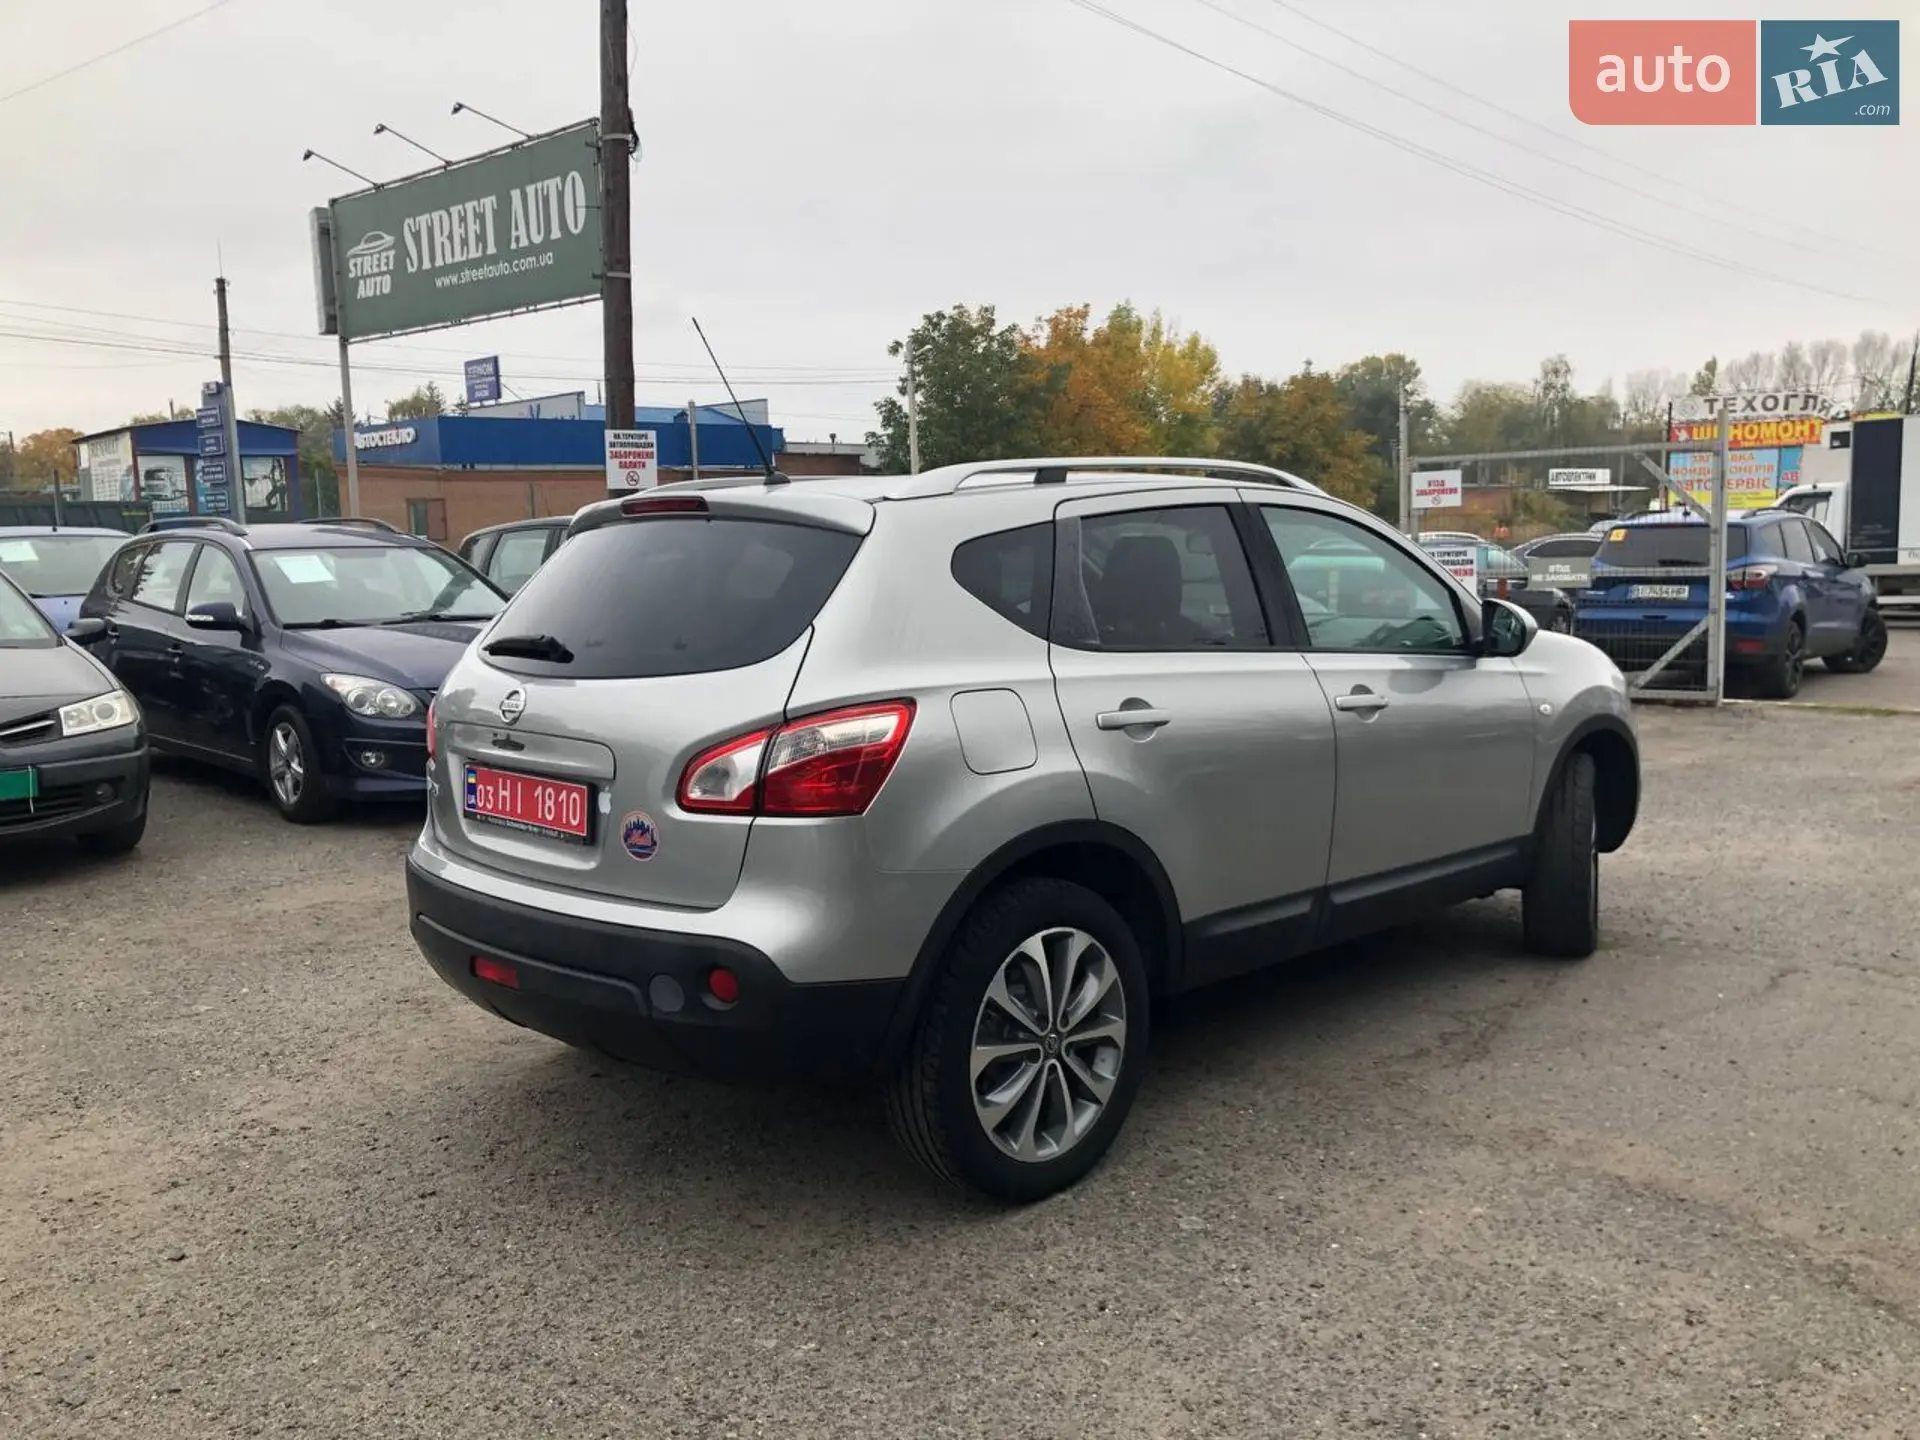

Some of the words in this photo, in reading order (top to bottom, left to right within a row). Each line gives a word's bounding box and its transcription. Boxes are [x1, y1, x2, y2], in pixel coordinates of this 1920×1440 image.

[402, 195, 497, 274] STREET
[509, 170, 587, 250] AUTO
[348, 249, 396, 278] STREET
[434, 251, 555, 289] www.streetauto.com.ua
[356, 274, 392, 299] AUTO
[609, 450, 655, 459] ЗАБОРОНЕНО
[534, 785, 581, 826] 1810
